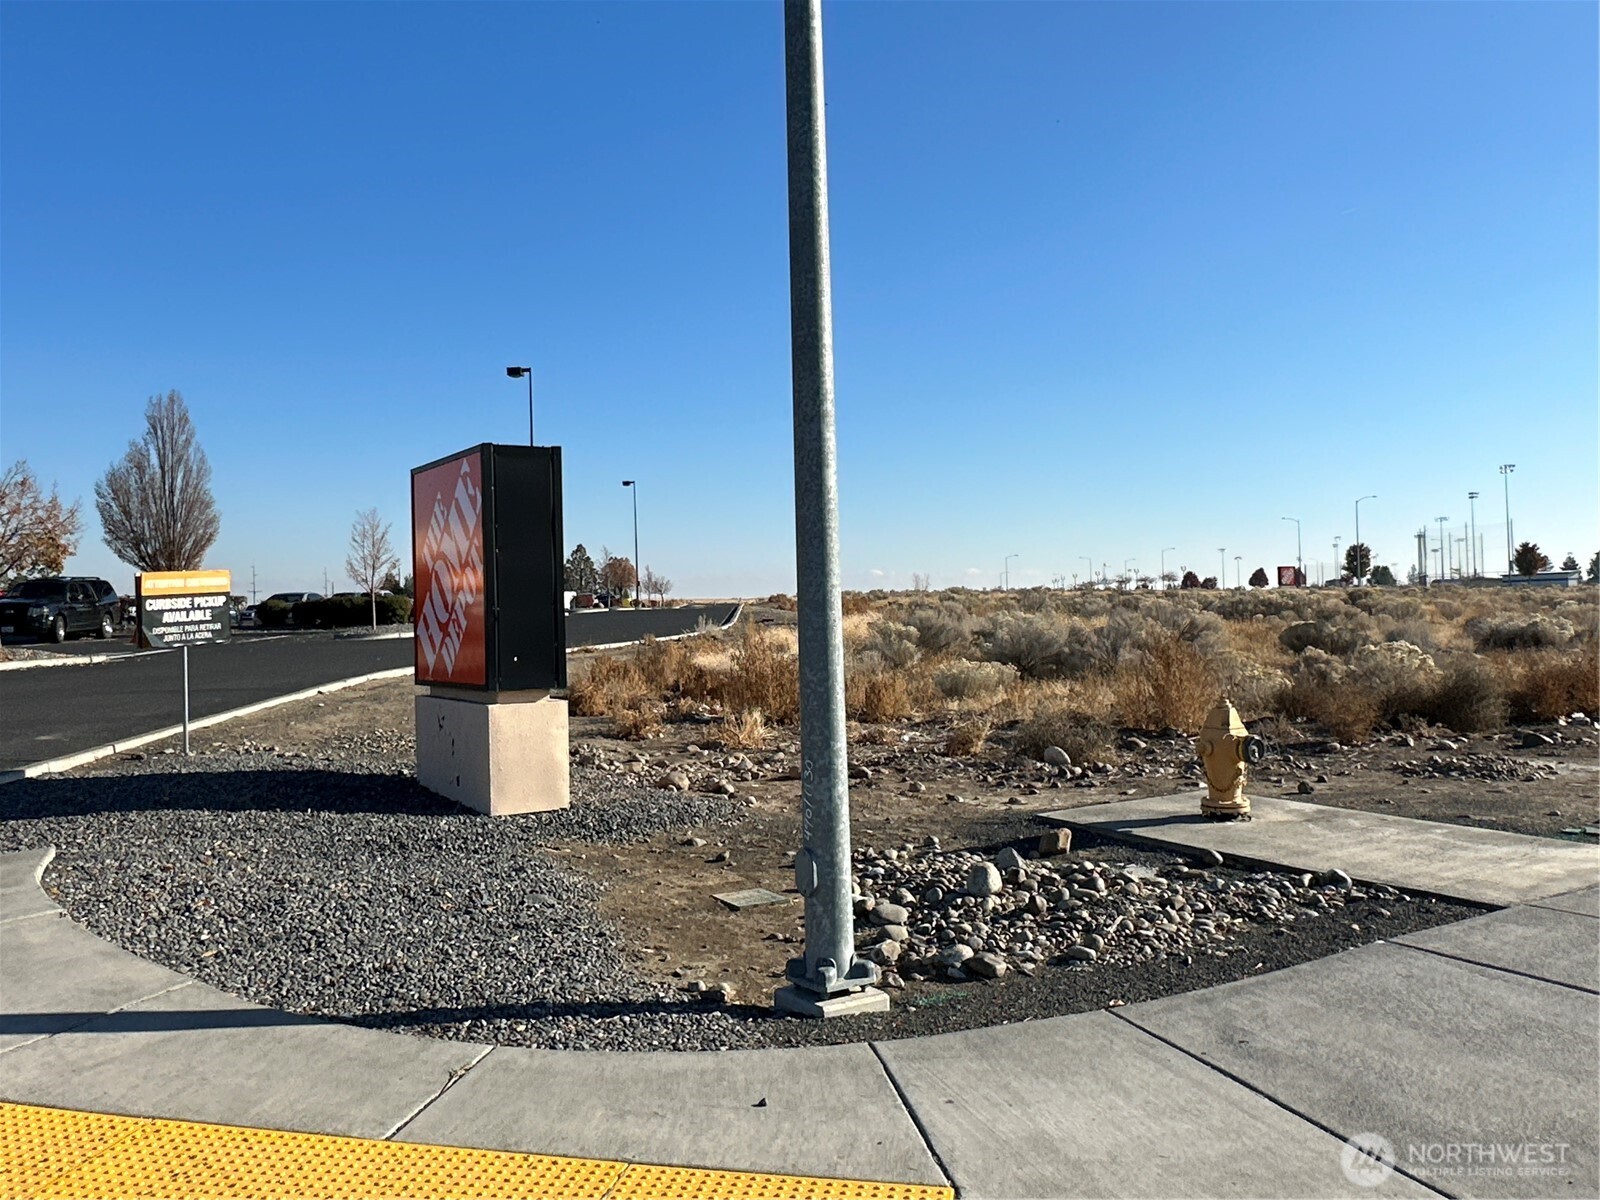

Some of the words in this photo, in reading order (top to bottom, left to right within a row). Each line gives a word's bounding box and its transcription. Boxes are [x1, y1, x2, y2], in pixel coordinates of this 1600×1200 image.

[422, 491, 448, 574] THE
[416, 457, 482, 677] HOME
[145, 598, 192, 611] CURBSIDE
[194, 596, 227, 608] PICKUP
[440, 535, 484, 679] DEPOT
[162, 610, 212, 623] AVAILABLE
[185, 624, 198, 632] PARA
[163, 633, 180, 642] JUNTO
[182, 633, 187, 641] A
[187, 632, 194, 640] LA
